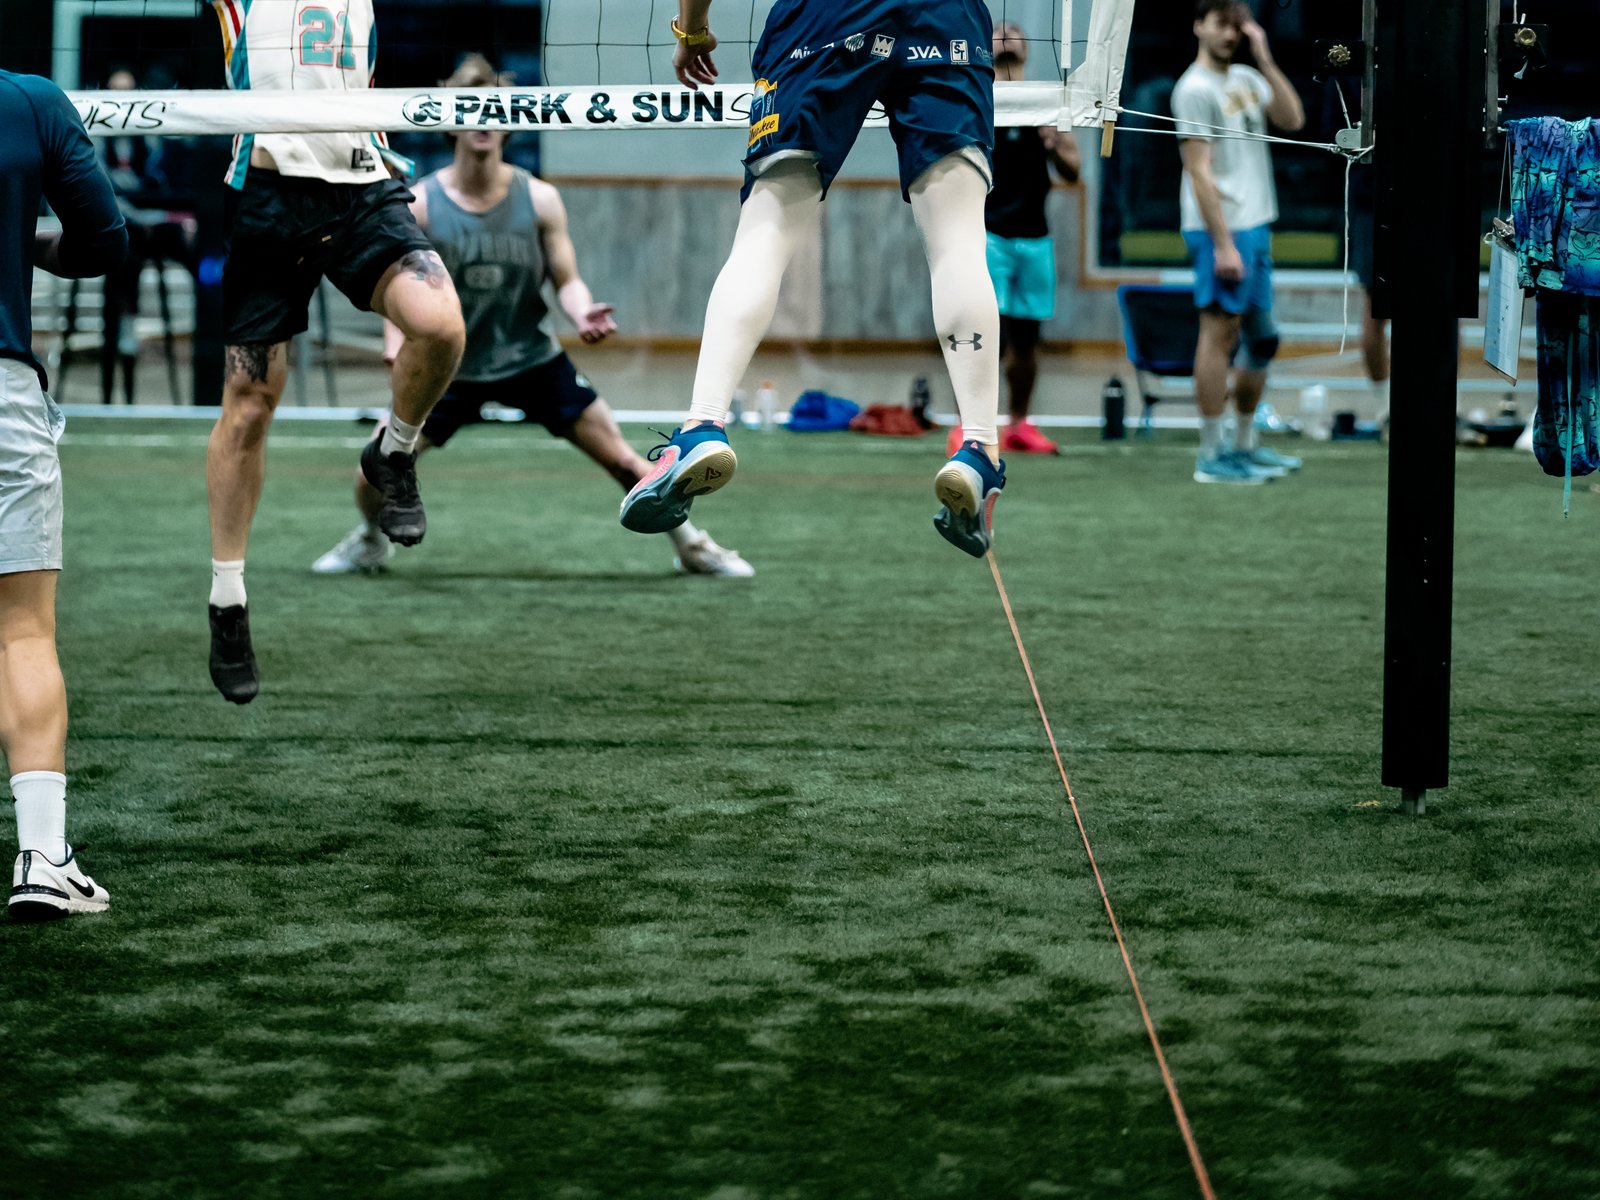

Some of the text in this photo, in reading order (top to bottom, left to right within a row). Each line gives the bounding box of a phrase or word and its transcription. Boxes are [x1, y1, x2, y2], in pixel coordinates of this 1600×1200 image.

[298, 5, 356, 70] 21
[907, 45, 943, 60] JVA
[455, 93, 572, 125] PARK
[586, 92, 618, 123] &
[631, 90, 724, 122] SUN
